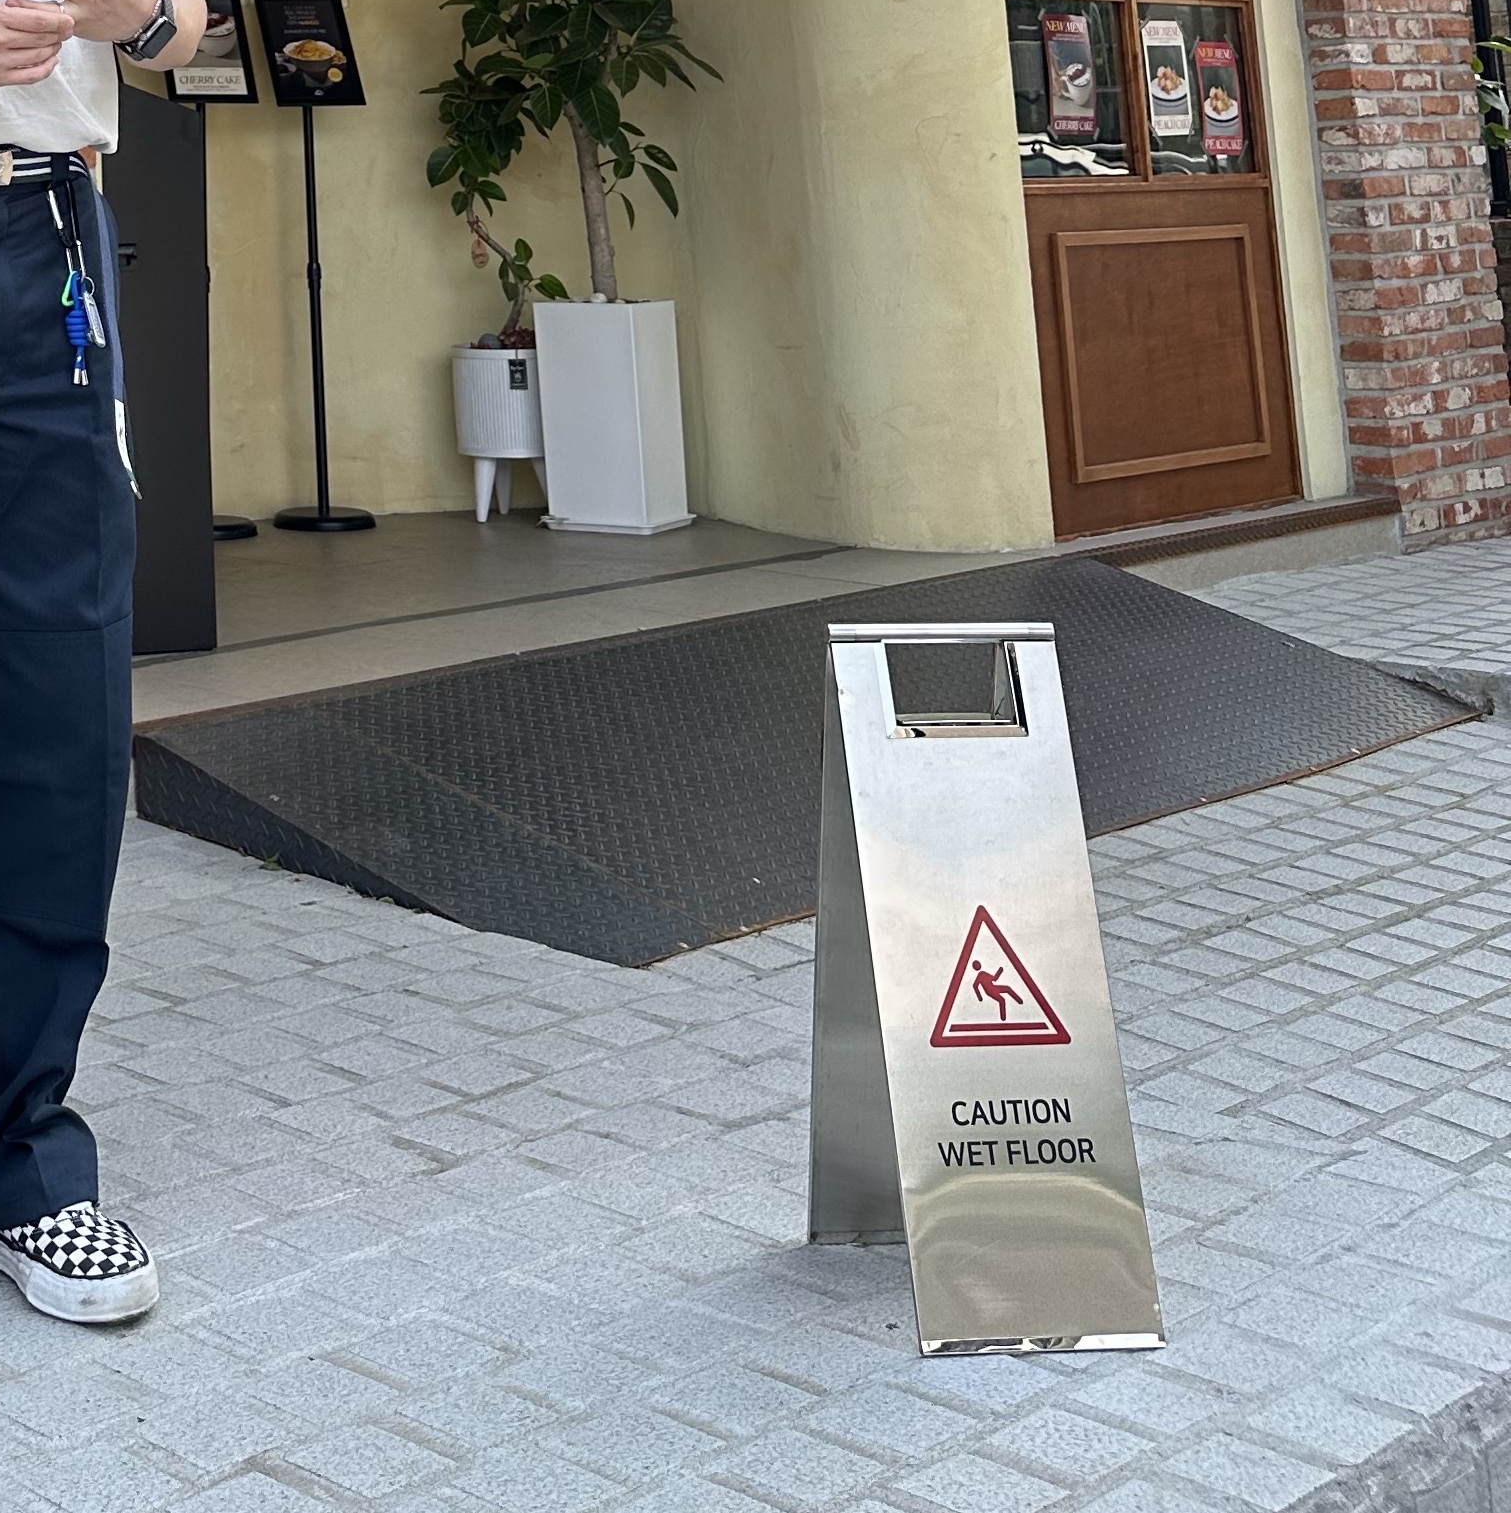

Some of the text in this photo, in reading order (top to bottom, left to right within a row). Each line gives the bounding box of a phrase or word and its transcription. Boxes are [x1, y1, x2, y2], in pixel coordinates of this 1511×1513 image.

[1046, 20, 1063, 31] NEW
[179, 75, 241, 85] CHERRY CAKE
[951, 1098, 1072, 1126] CAUTION
[938, 1138, 1096, 1167] WET FLOOR
